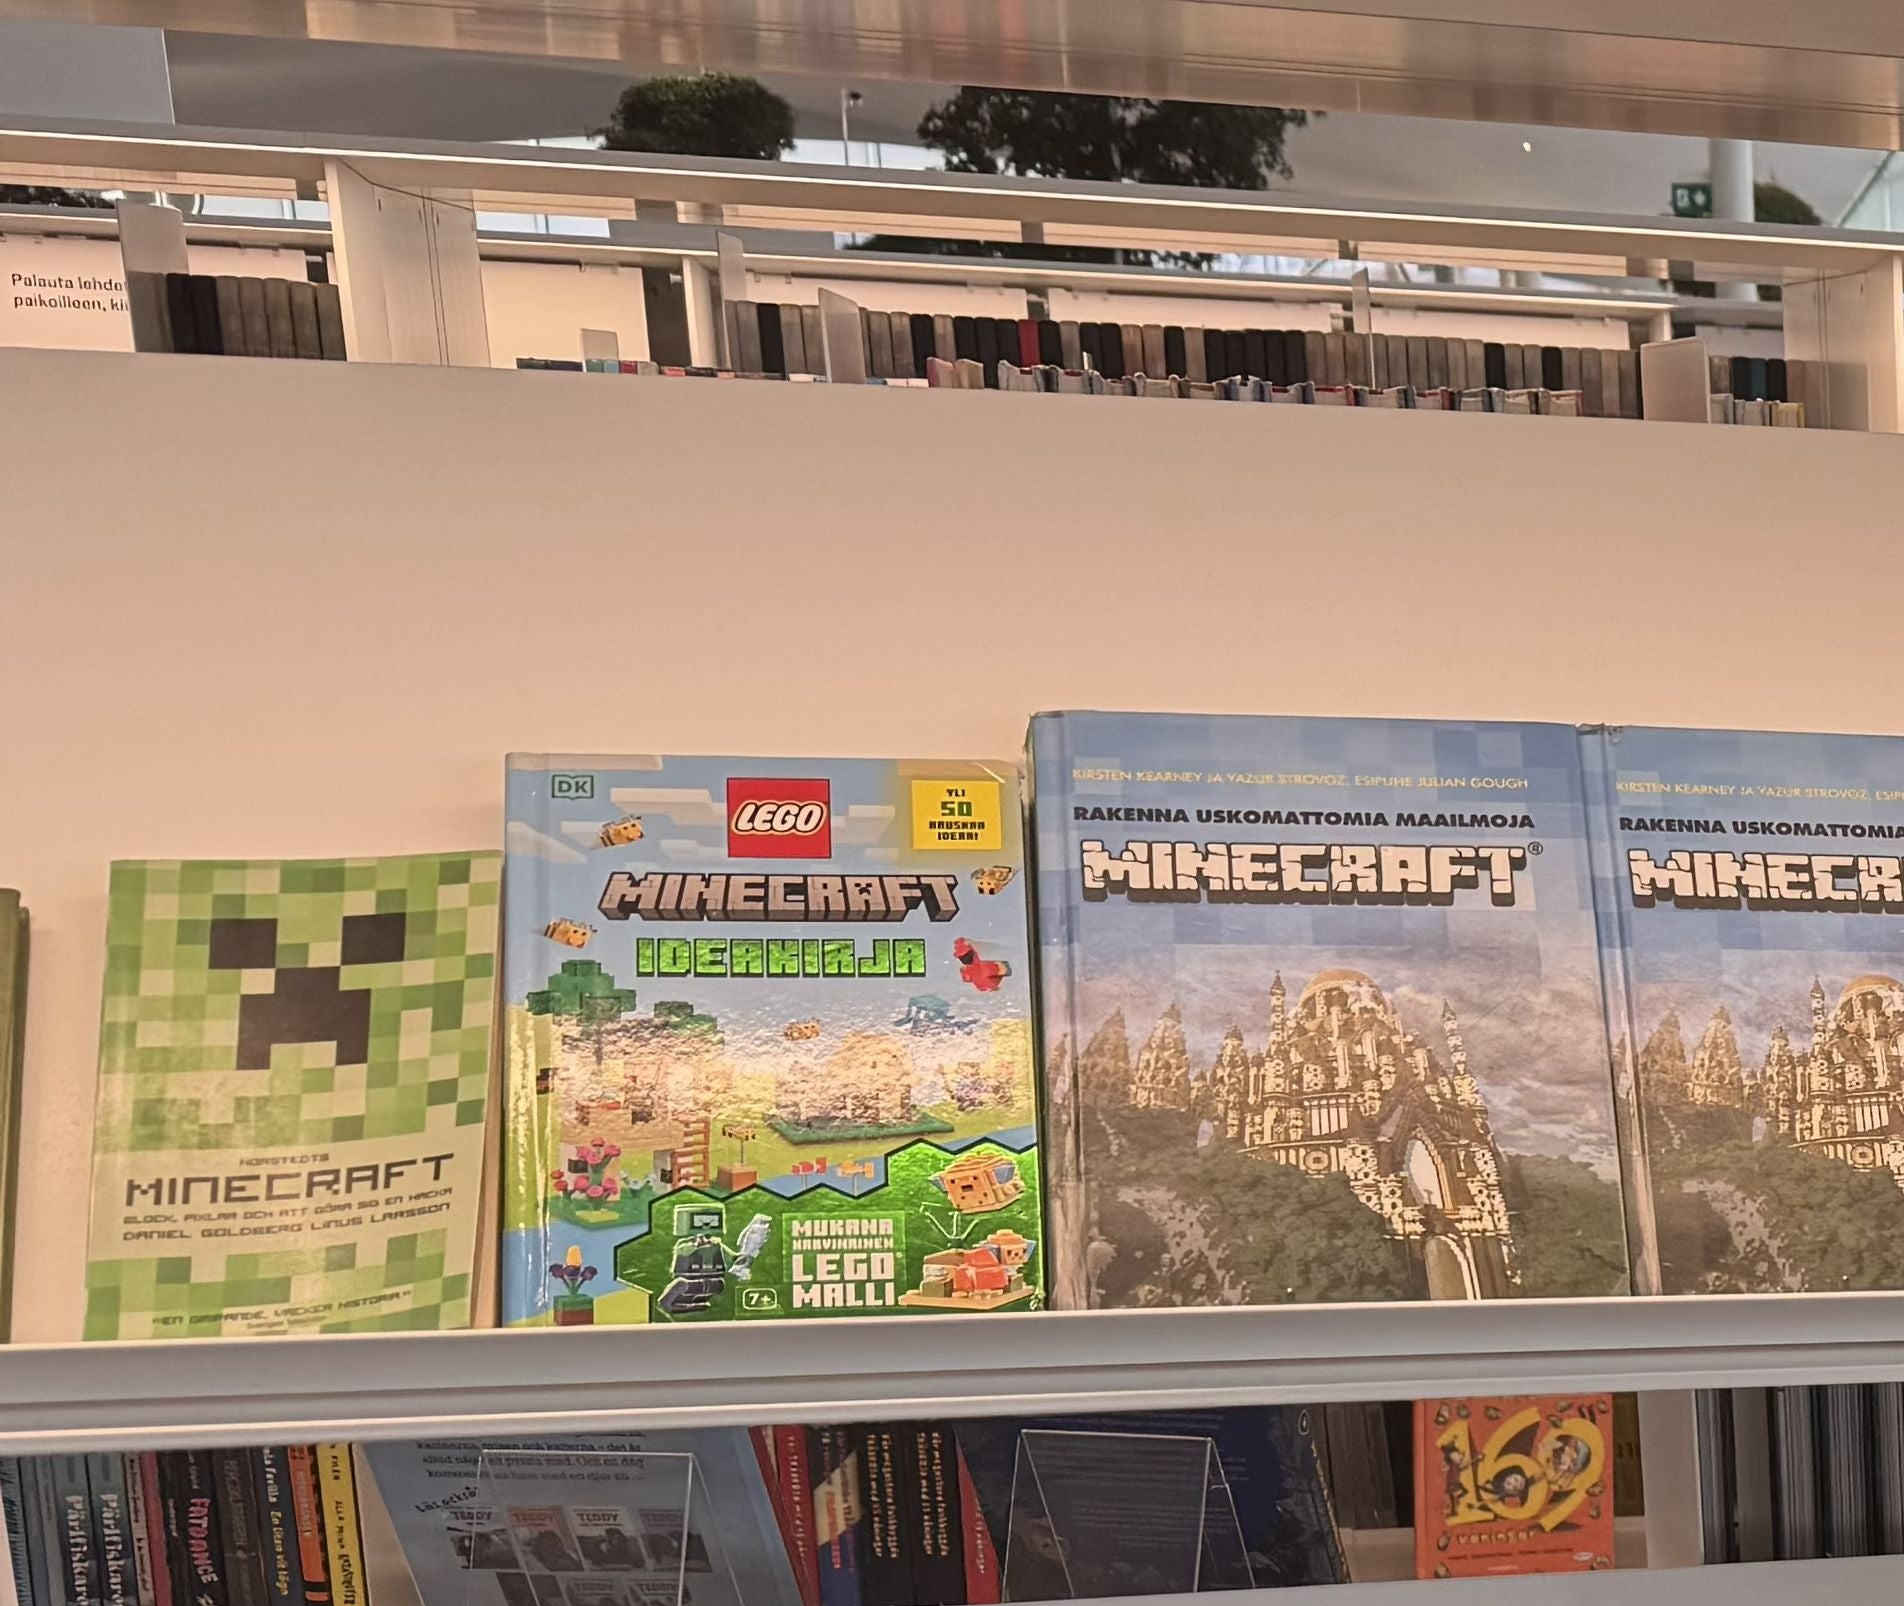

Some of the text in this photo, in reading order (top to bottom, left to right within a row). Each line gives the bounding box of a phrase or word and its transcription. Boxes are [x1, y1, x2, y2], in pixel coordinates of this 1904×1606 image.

[732, 800, 827, 835] LEGO
[1073, 806, 1535, 830] RAKENNA USKOMATTOMIA MAAILMOJA
[1619, 816, 1726, 835] RAKENNA
[599, 872, 958, 923] MINECRAFT
[636, 938, 926, 978] IDEAKIRJA
[125, 1153, 455, 1207] MINECRAFT
[201, 1224, 303, 1239] GOLDBERG
[792, 1218, 894, 1237] MUKANA
[792, 1253, 894, 1281] LEGO
[792, 1282, 895, 1308] MALLI
[1435, 1406, 1605, 1532] 169
[576, 1513, 619, 1523] TEDDY
